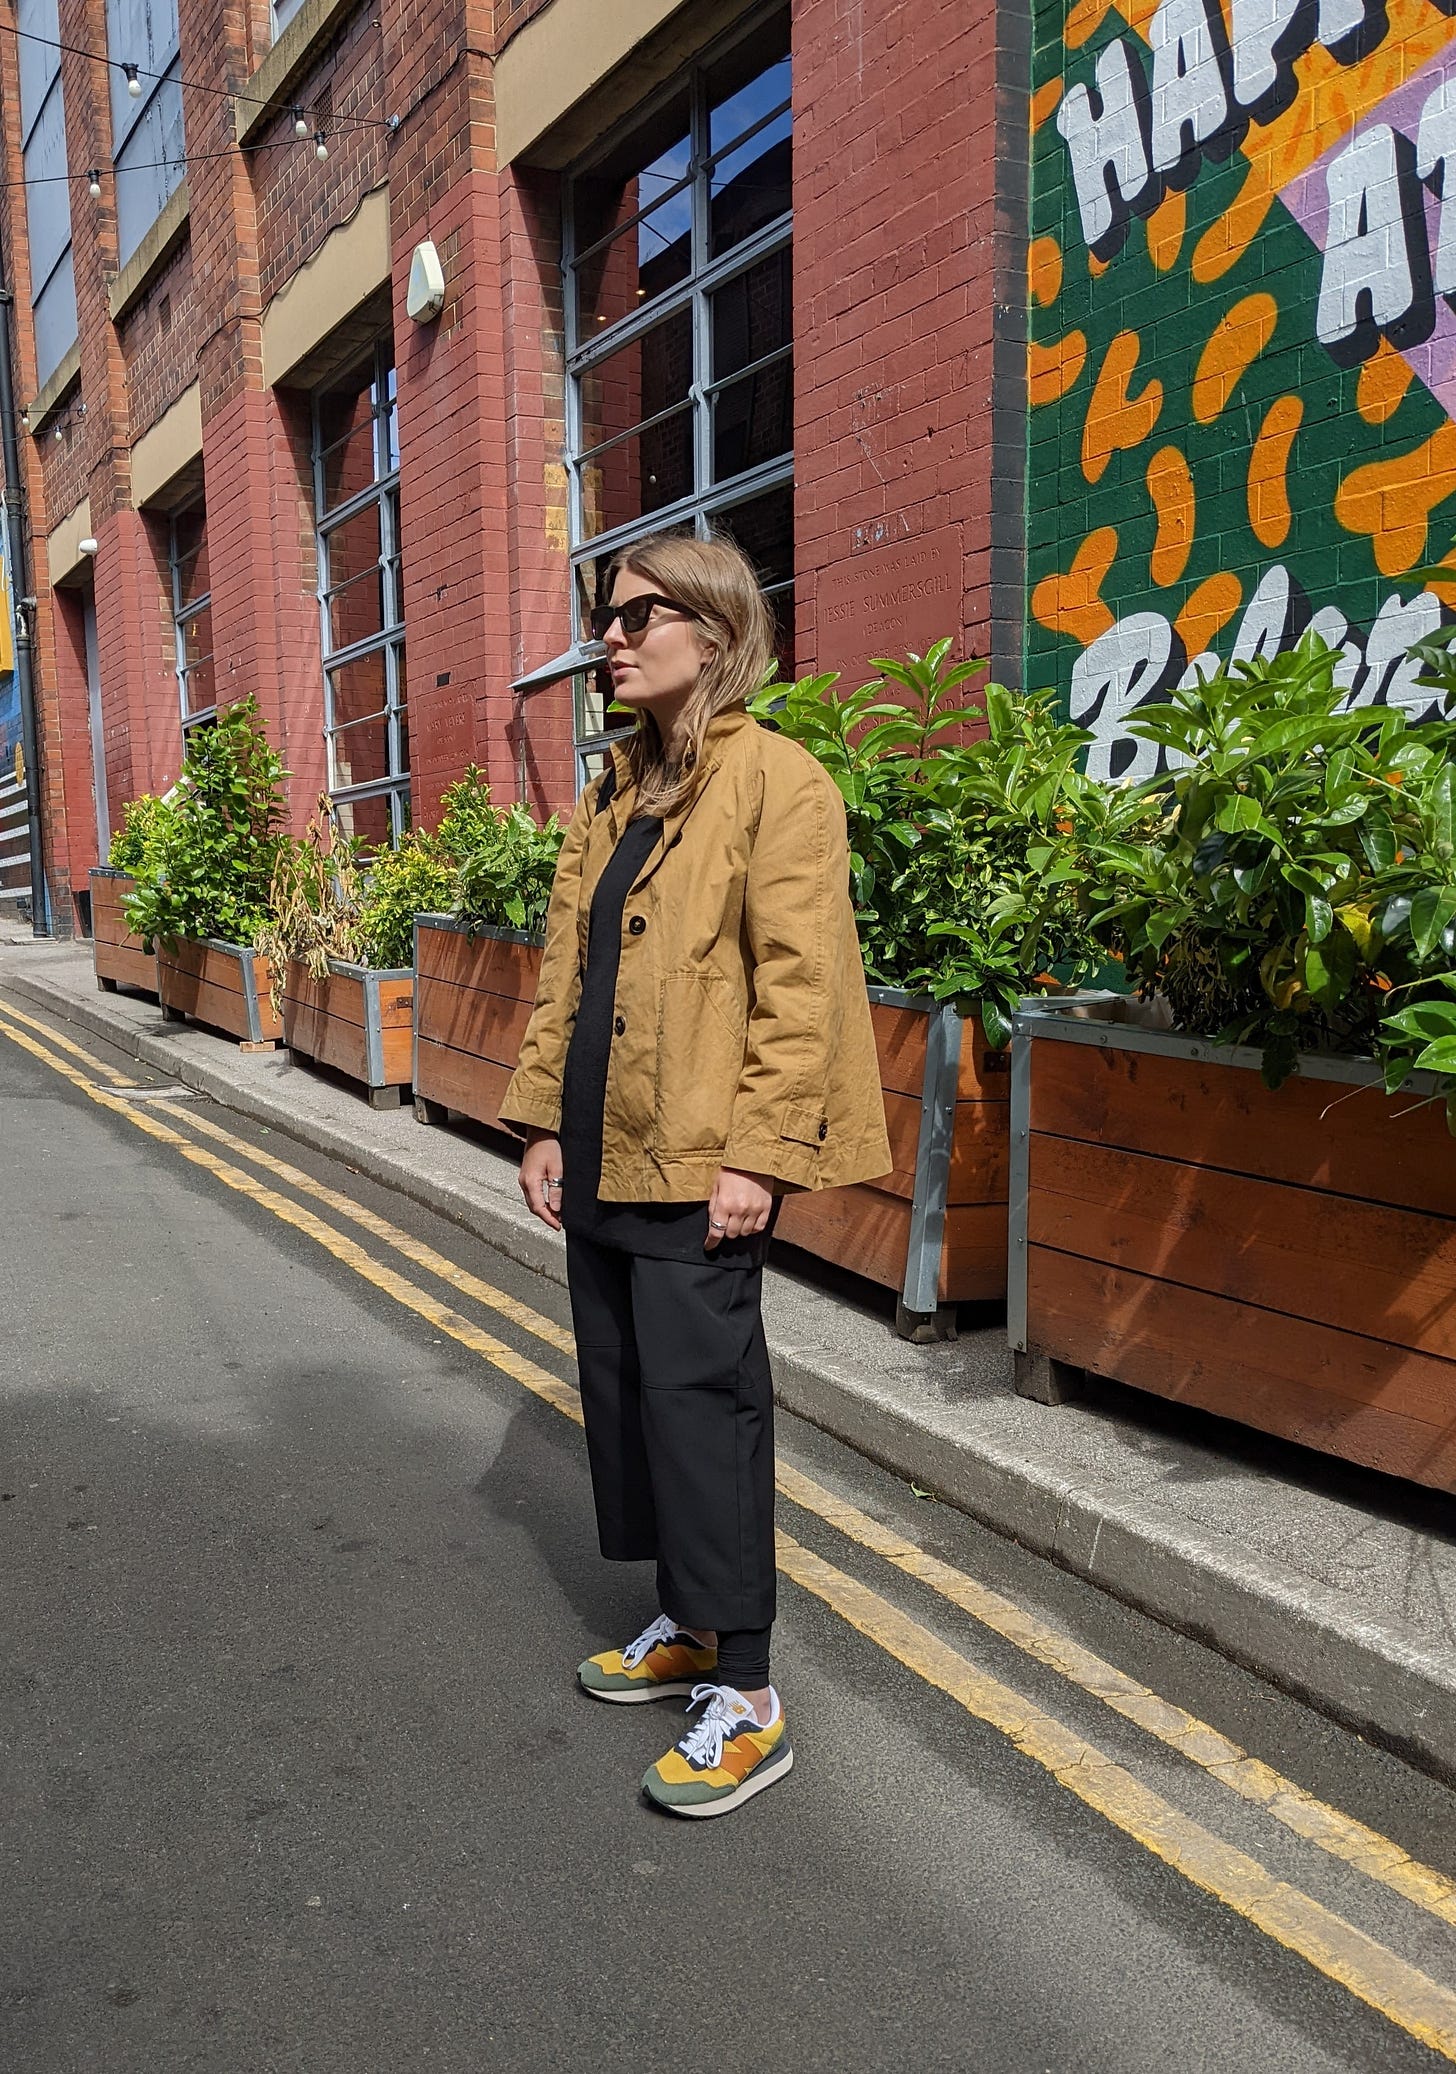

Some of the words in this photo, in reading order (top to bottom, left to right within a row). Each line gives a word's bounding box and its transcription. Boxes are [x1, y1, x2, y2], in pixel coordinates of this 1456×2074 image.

[854, 565, 880, 583] STONE
[882, 558, 901, 574] WAS
[904, 551, 926, 569] LAID
[930, 546, 943, 560] BY
[863, 573, 952, 614] SUMMERSGILL
